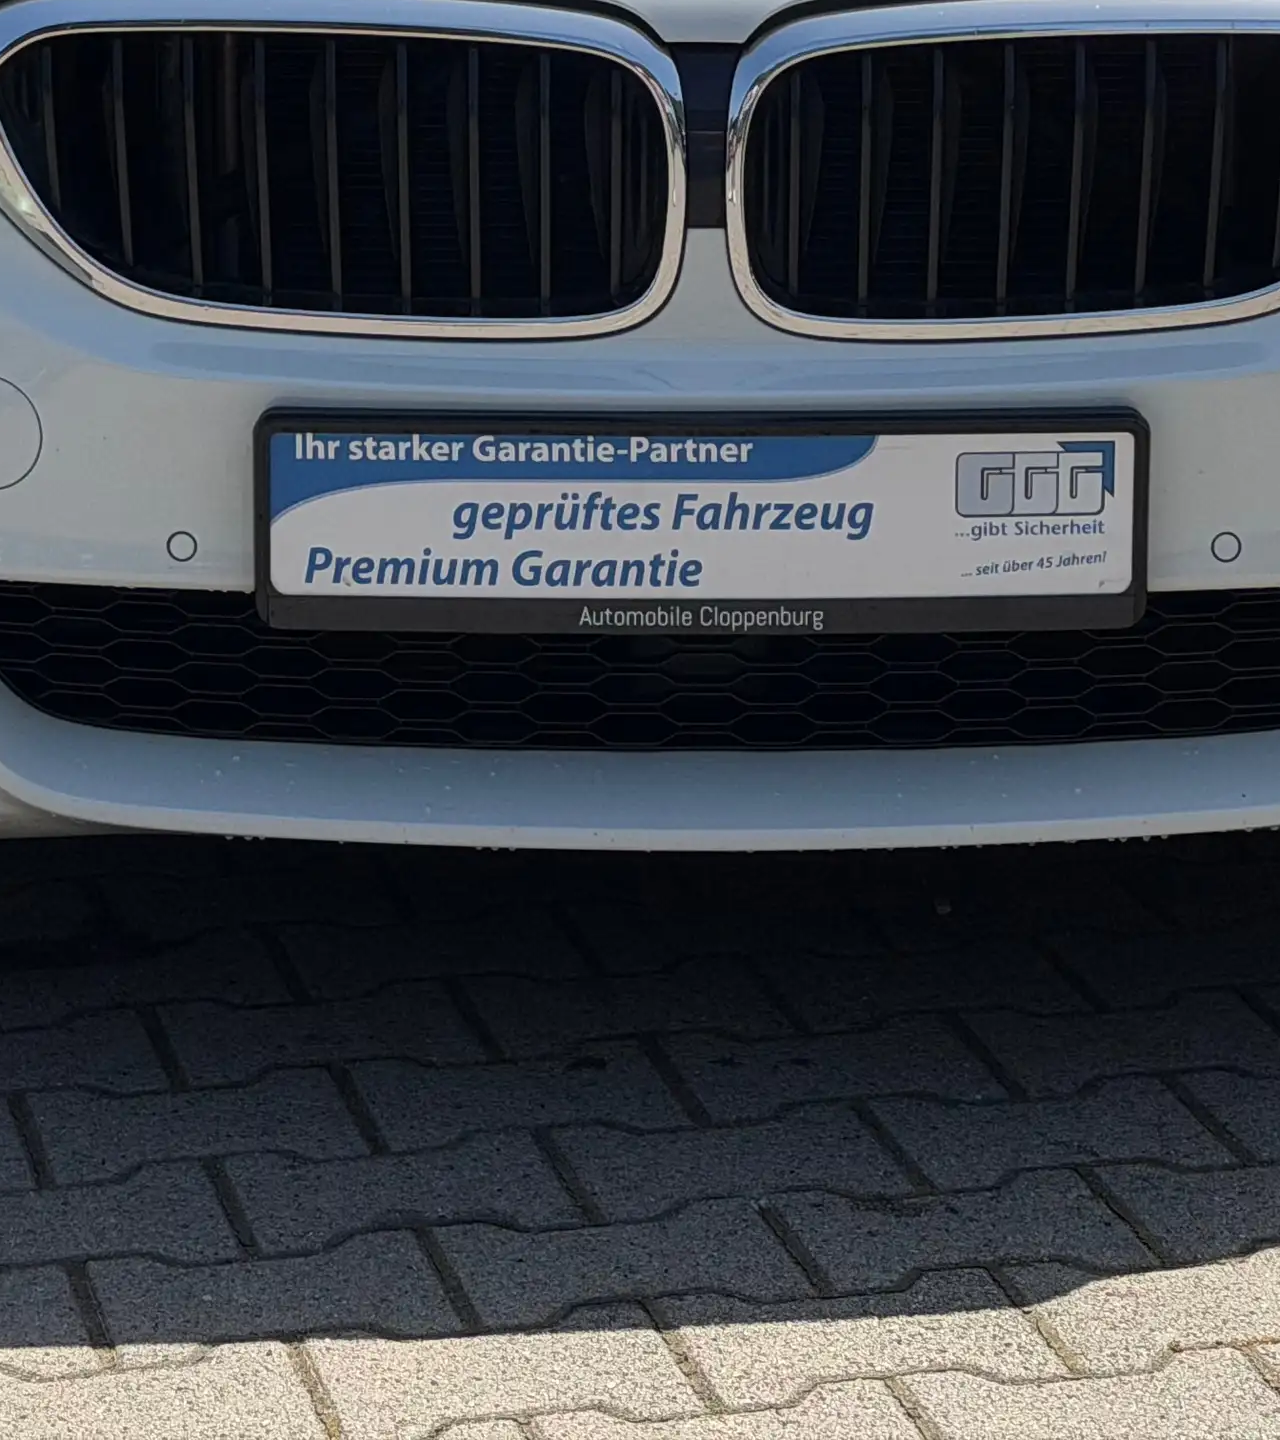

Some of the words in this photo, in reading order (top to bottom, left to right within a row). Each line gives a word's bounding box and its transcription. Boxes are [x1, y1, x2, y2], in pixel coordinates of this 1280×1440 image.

[295, 433, 340, 461] Ihr
[348, 434, 464, 462] starker
[472, 435, 753, 463] Garantie-Partner
[452, 490, 661, 541] geprüftes
[671, 491, 875, 541] Fahrzeug
[1014, 520, 1105, 536] Sicherheit
[304, 547, 500, 587] Premium
[511, 549, 703, 588] Garantie
[976, 562, 1000, 576] seit
[1003, 559, 1034, 574] über
[1036, 555, 1053, 570] 45
[1056, 551, 1107, 568] Jahren!
[579, 605, 694, 628] Automobile
[699, 605, 825, 631] Cloppenburg
